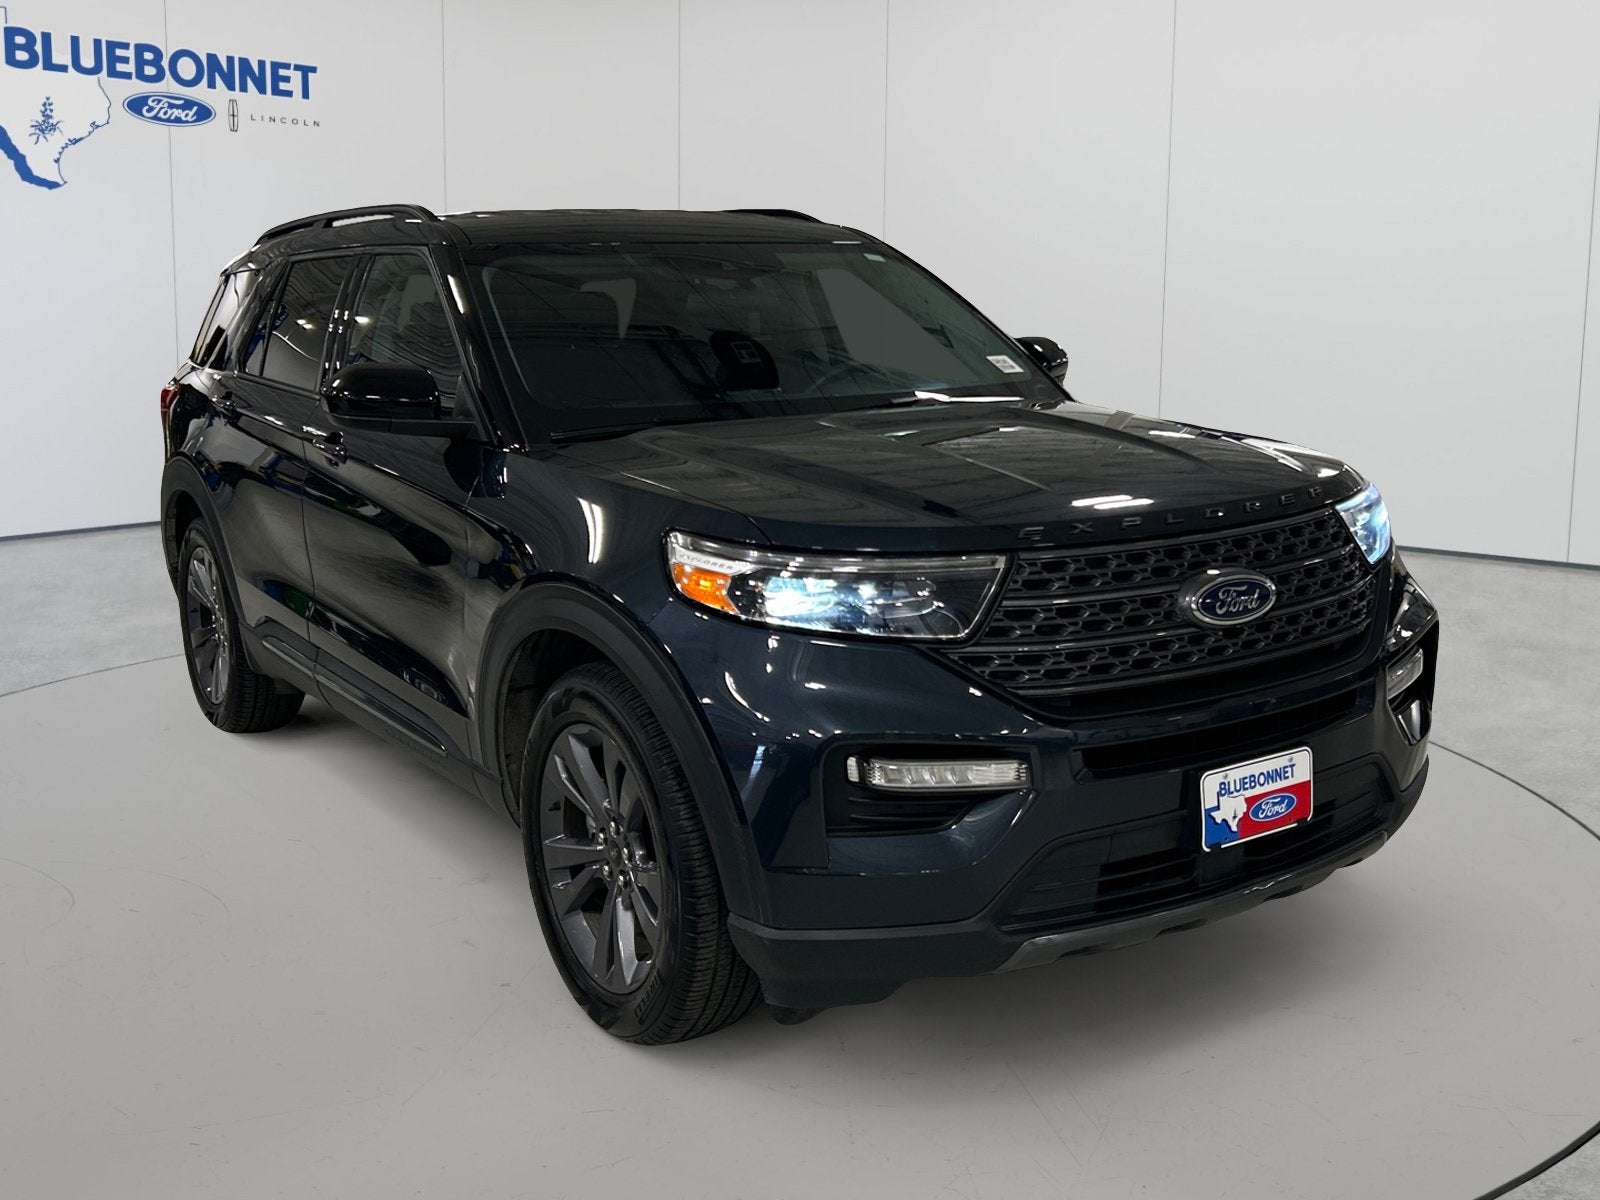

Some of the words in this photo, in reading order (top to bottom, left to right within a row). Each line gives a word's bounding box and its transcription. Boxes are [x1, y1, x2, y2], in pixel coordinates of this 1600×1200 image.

[3, 26, 318, 101] BLUEBONNET
[142, 96, 198, 122] Ford
[250, 113, 321, 128] LINCOLN
[1017, 486, 1324, 541] EXPLORER
[1215, 585, 1260, 615] Ford
[1219, 764, 1296, 798] BLUEBONNET
[1259, 798, 1288, 818] Ford
